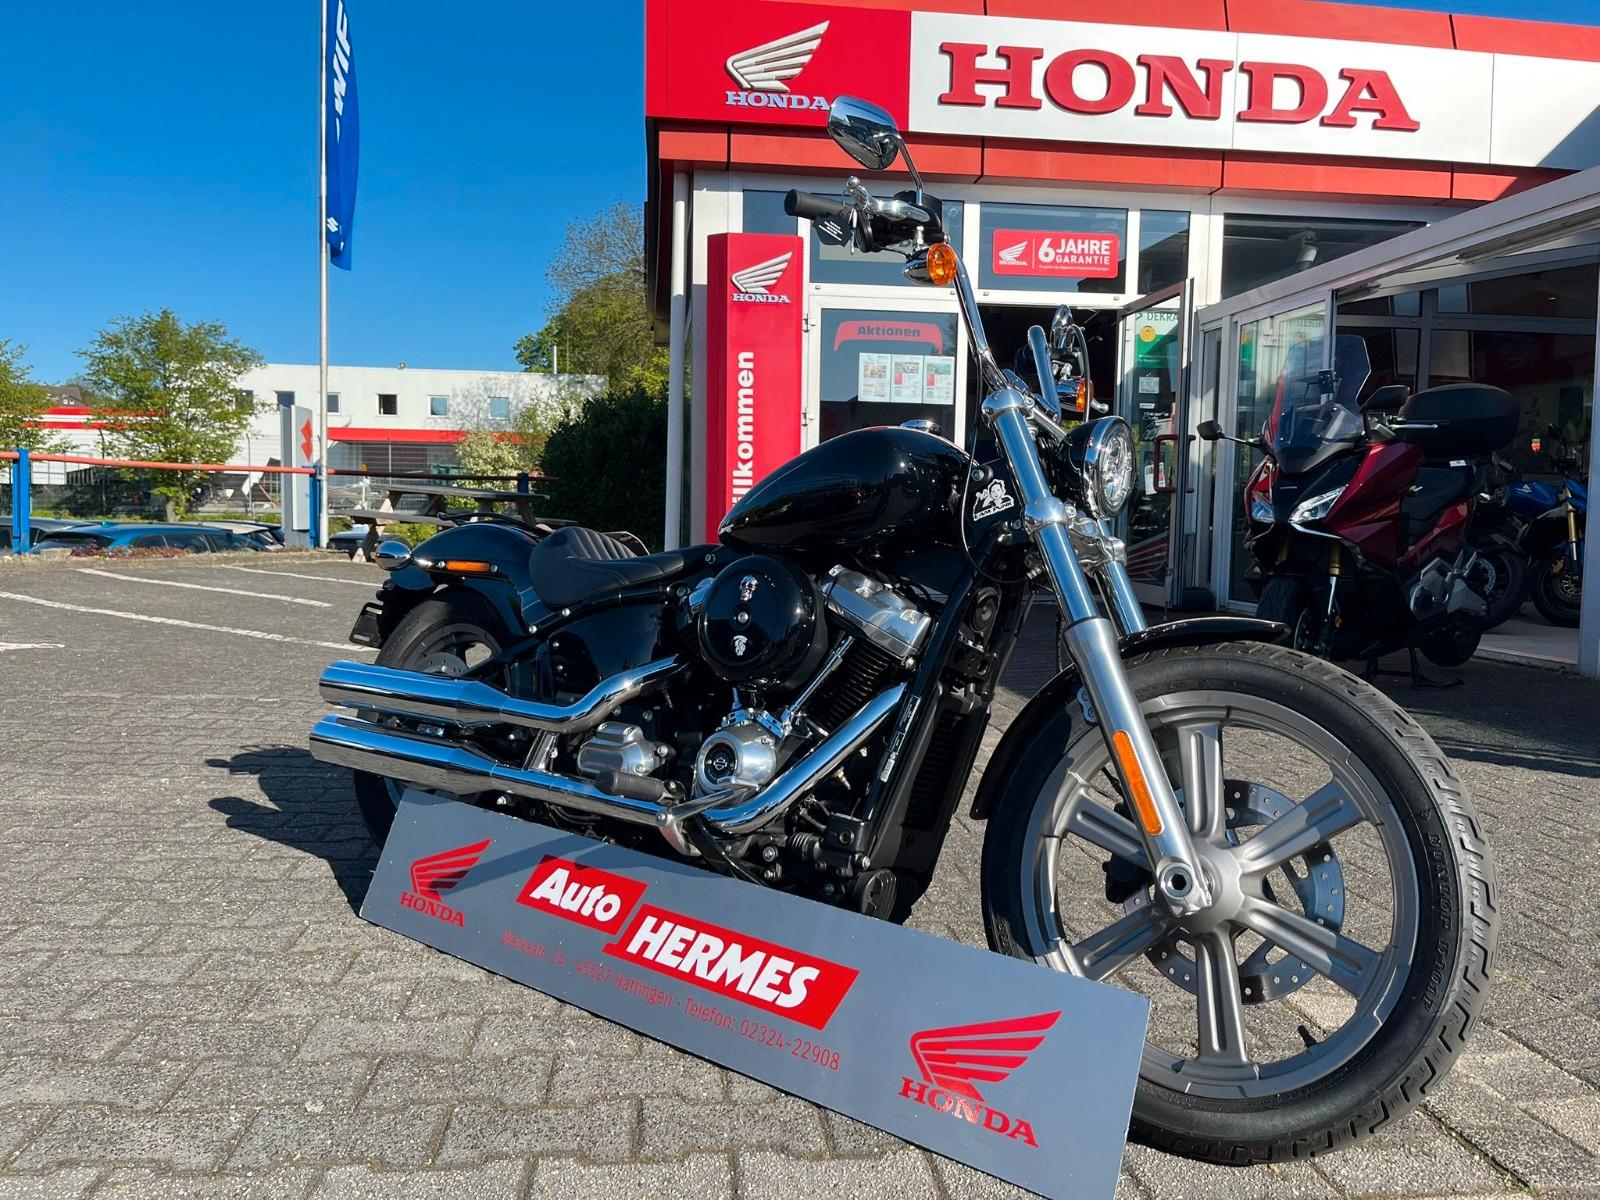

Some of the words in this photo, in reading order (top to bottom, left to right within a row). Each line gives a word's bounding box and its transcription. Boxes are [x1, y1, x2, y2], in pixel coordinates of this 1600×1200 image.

[725, 90, 830, 111] HONDA
[939, 42, 1420, 132] HONDA
[1038, 238, 1055, 263] 6
[1056, 239, 1110, 255] JAHRE
[1056, 255, 1110, 265] GARANTIE
[732, 293, 791, 303] HONDA
[857, 325, 921, 337] Aktionen
[732, 351, 754, 507] llkommen
[529, 868, 621, 922] Auto
[1427, 831, 1451, 930] DUNLOP
[400, 890, 464, 928] HONDA
[626, 916, 820, 1009] HERMES
[615, 974, 673, 1008] Hattingen
[684, 996, 737, 1032] Telefon:
[740, 1019, 840, 1070] 02324-22908
[899, 1076, 1040, 1149] HONDA
